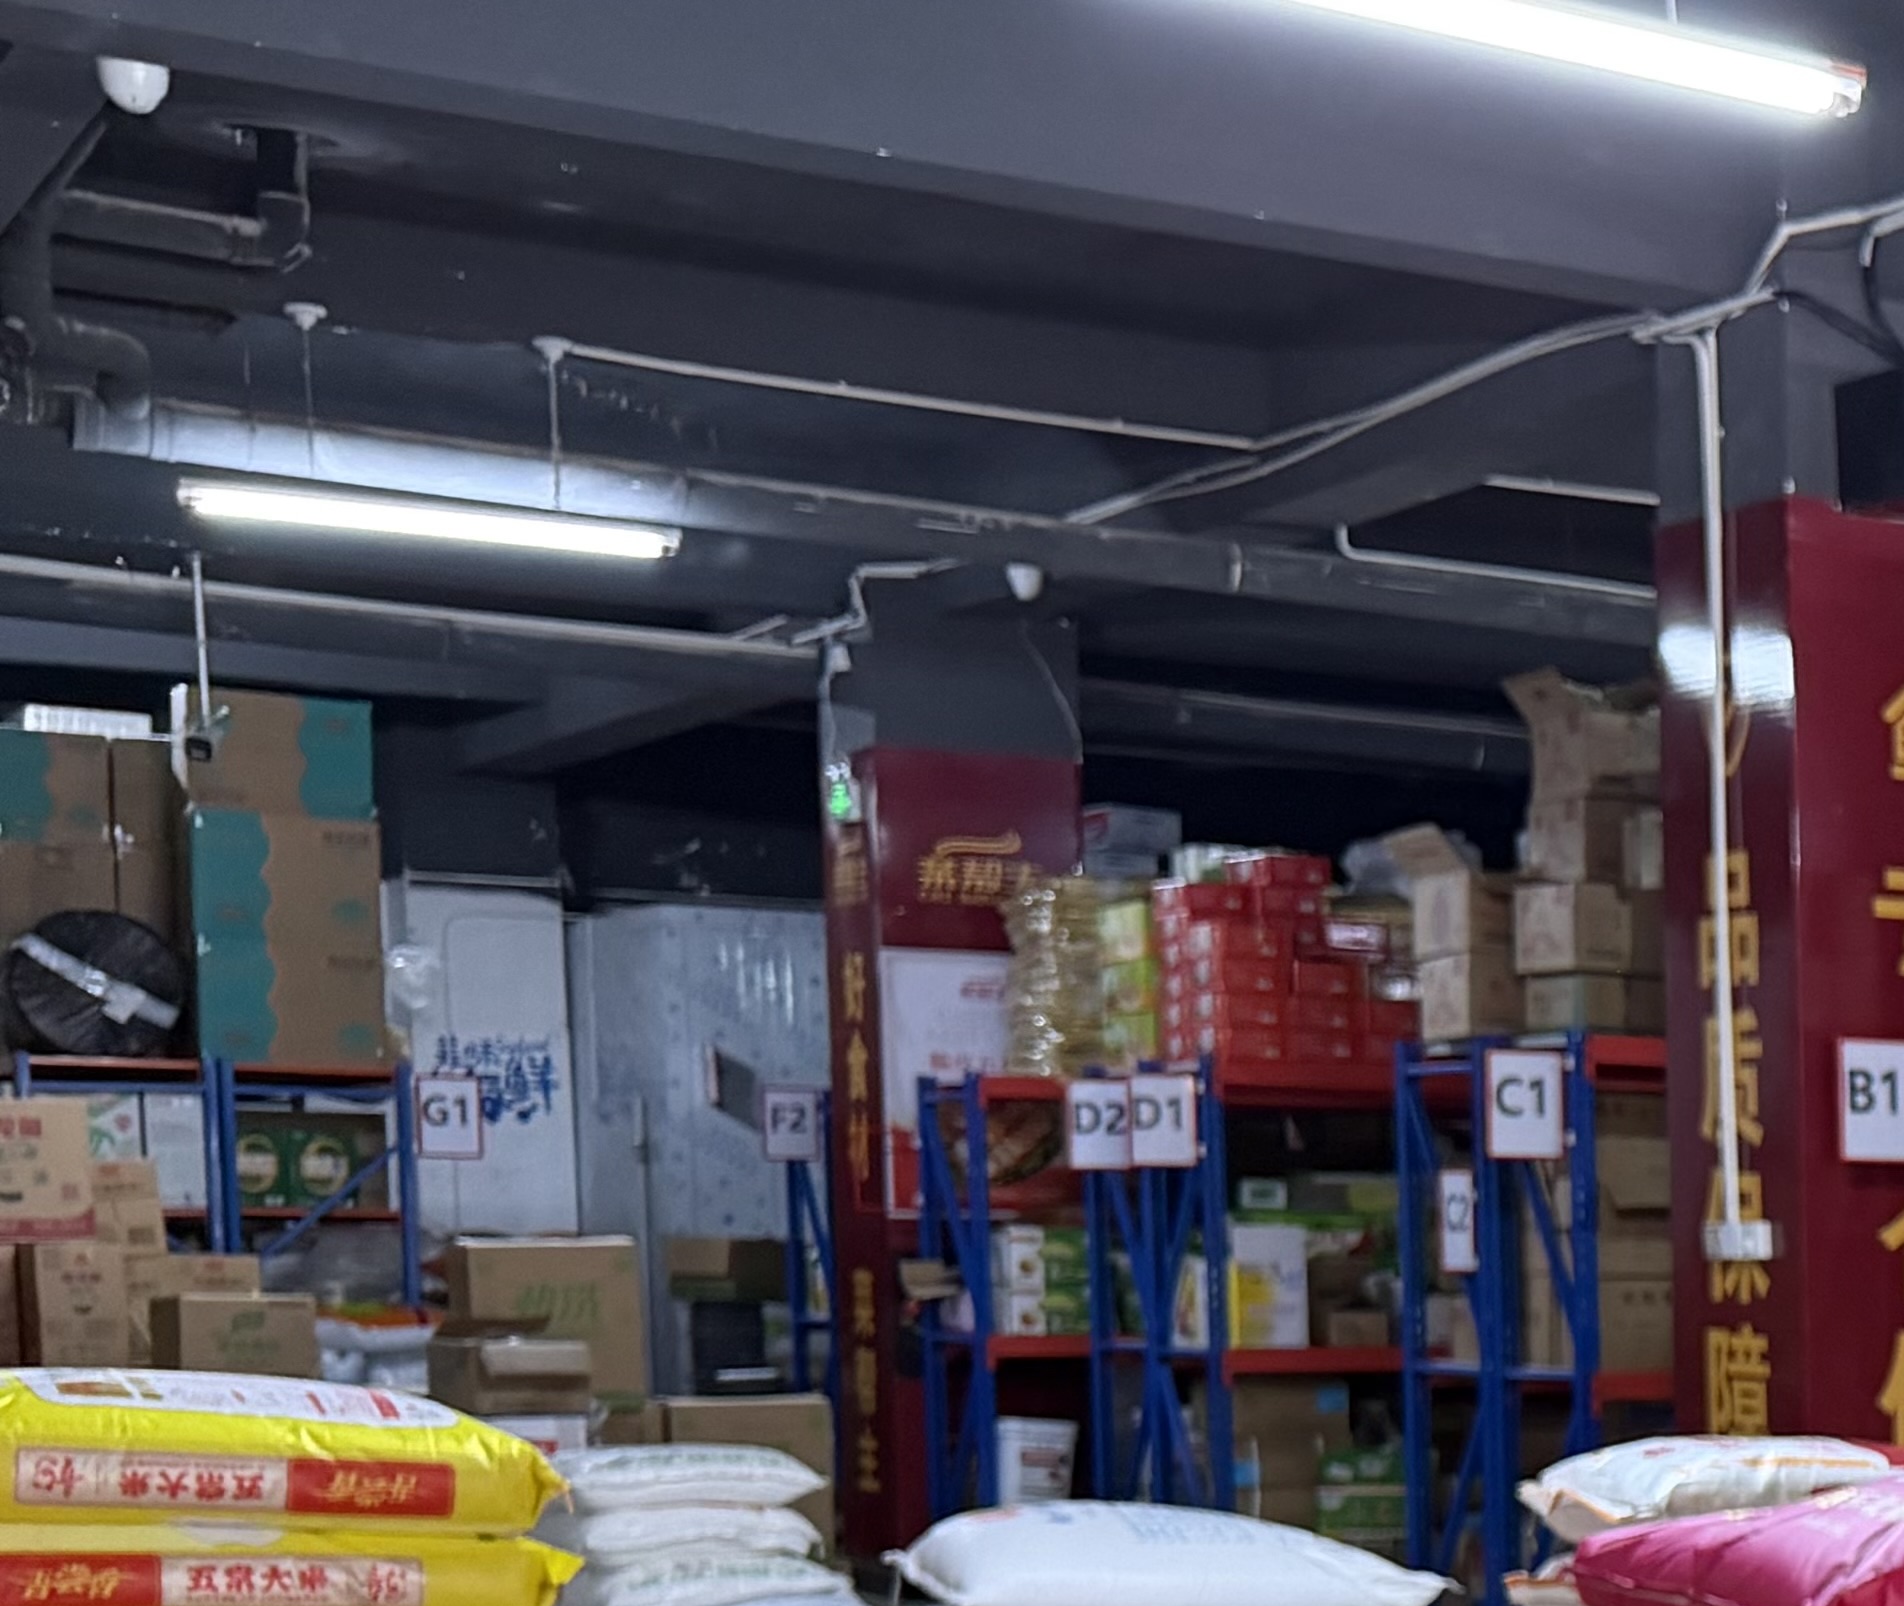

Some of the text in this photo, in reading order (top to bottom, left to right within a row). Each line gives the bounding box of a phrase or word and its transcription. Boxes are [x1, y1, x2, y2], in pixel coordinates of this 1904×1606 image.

[419, 1090, 471, 1129] G1
[1494, 1079, 1547, 1118] C1
[1848, 1070, 1900, 1115] B1
[769, 1104, 809, 1136] F2
[1073, 1102, 1128, 1137] D2
[1132, 1094, 1187, 1132] D1
